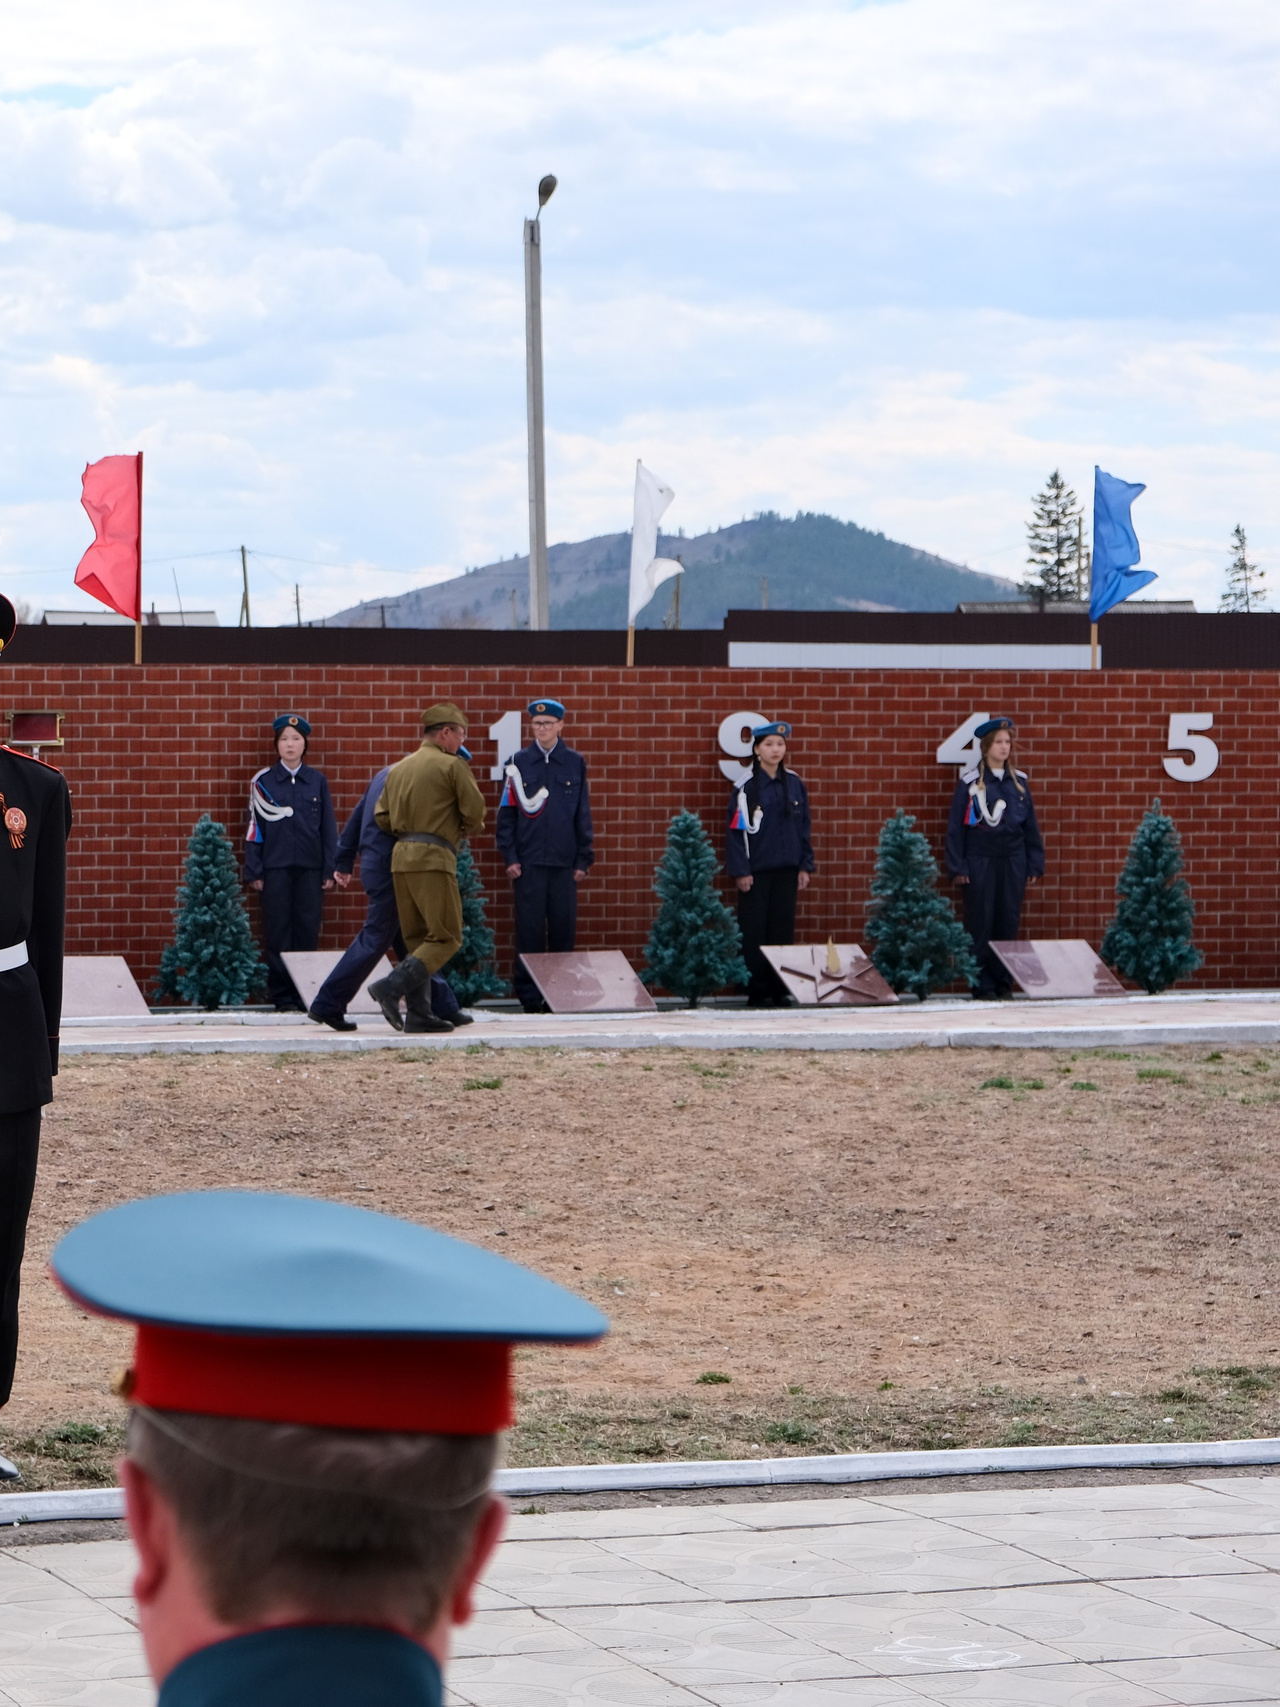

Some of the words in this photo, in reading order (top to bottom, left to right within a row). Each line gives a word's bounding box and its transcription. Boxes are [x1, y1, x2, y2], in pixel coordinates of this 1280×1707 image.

[489, 711, 522, 781] 1
[718, 711, 771, 782] 9
[936, 711, 990, 780] 4
[1163, 712, 1219, 783] 5
